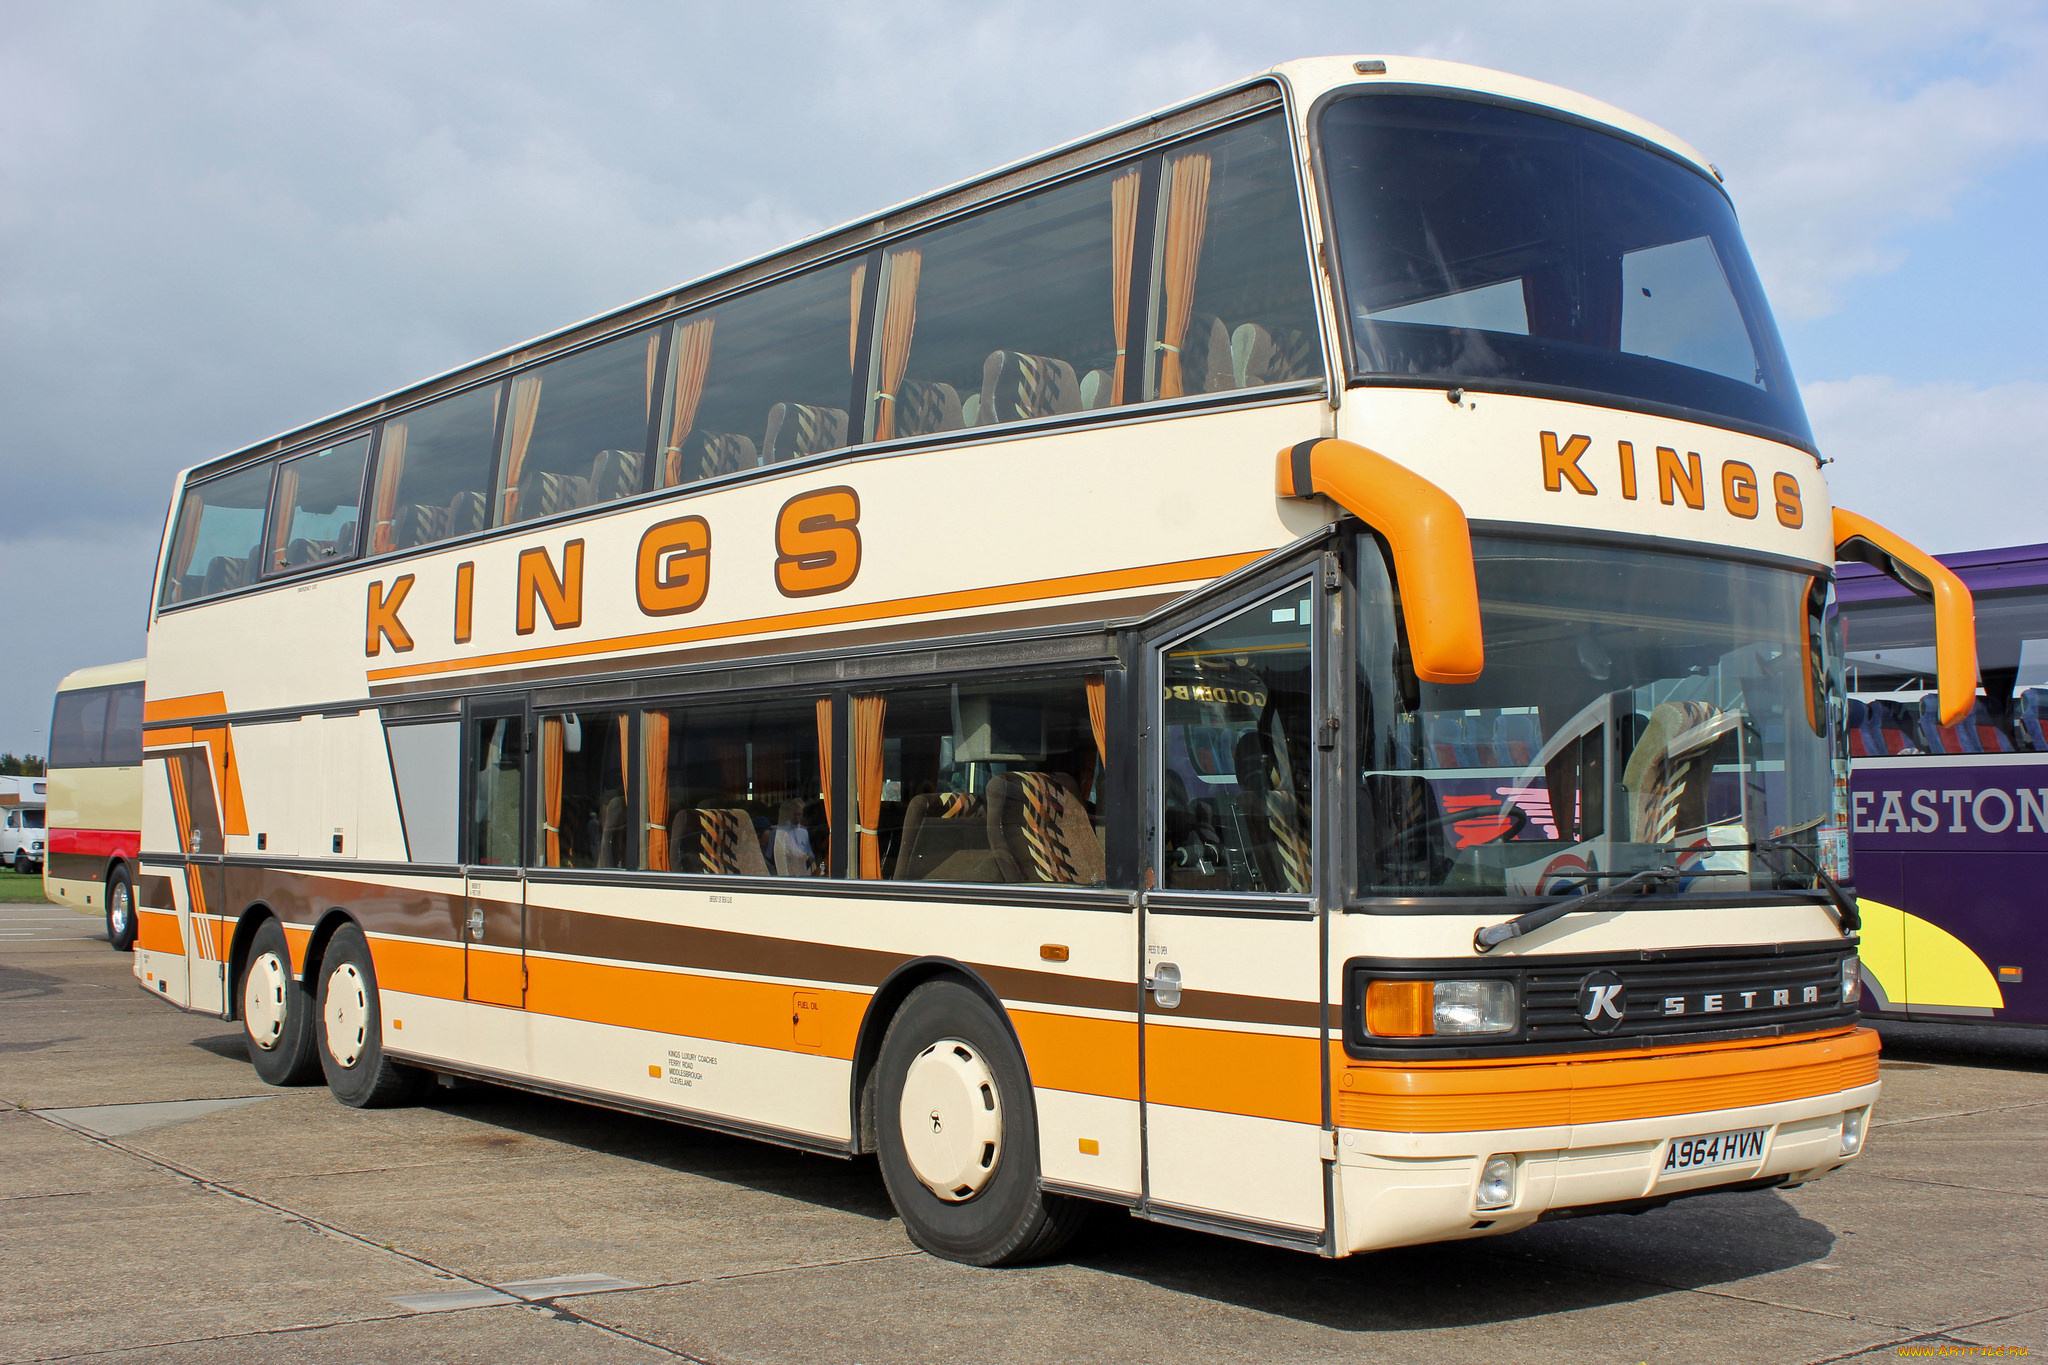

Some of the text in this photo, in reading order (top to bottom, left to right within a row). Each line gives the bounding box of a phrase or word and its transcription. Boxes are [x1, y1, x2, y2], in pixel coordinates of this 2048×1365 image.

[1540, 431, 1803, 530] KINGS
[365, 485, 862, 658] KINGS
[1665, 986, 1817, 1015] SETRA
[668, 1050, 718, 1065] KINGS LUXURY COACHES
[669, 1059, 693, 1070] FERRY ROAD
[669, 1068, 703, 1080] MIDDLESBROUGH
[670, 1077, 692, 1087] CLEVELAND
[1664, 1131, 1764, 1170] A964 HVN
